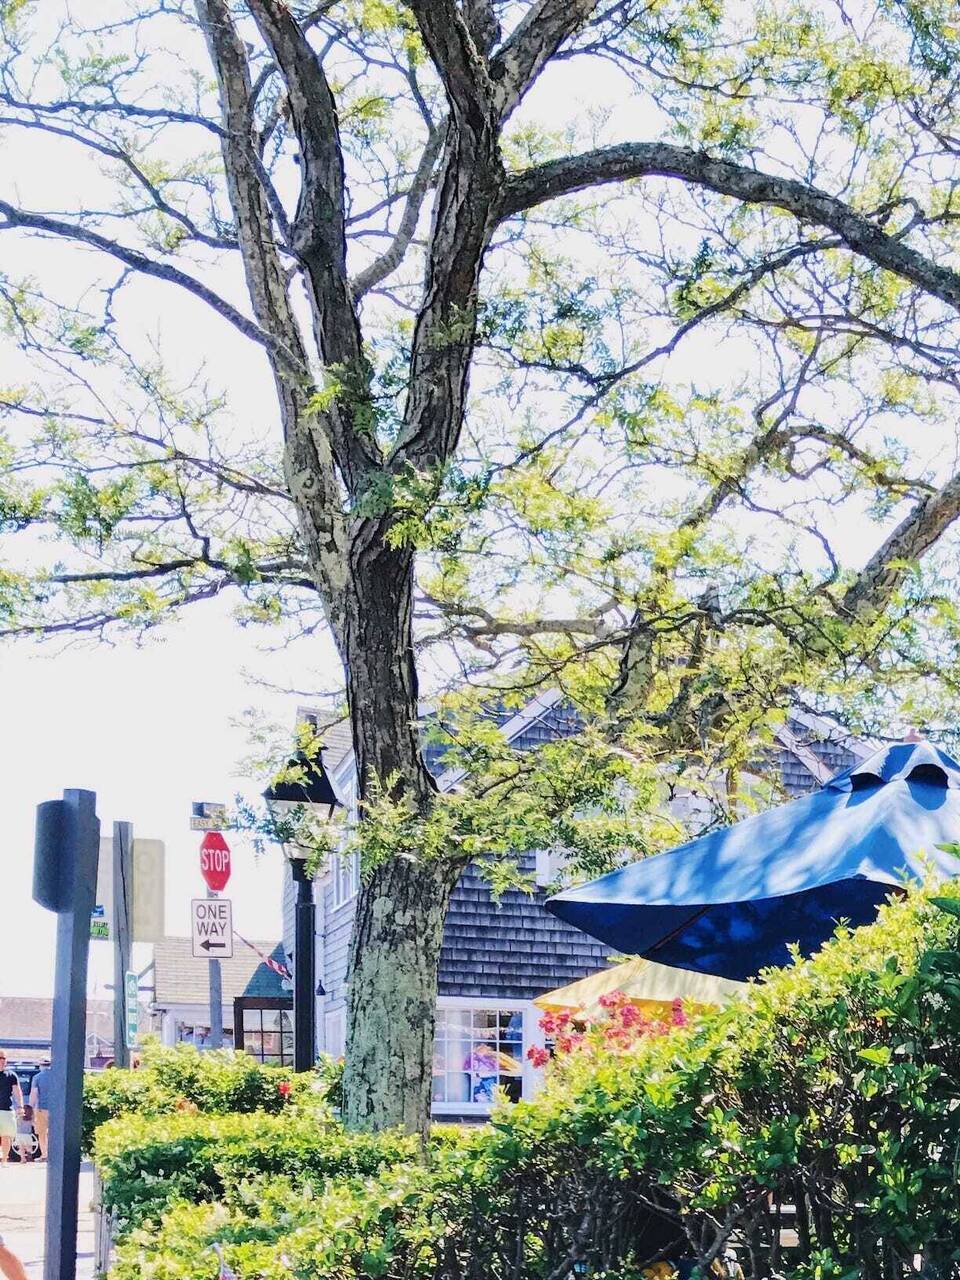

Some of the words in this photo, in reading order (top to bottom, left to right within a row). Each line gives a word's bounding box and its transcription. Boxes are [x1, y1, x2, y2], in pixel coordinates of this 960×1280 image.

[201, 849, 229, 871] STOP
[196, 904, 227, 919] ONE
[196, 921, 227, 936] WAY
